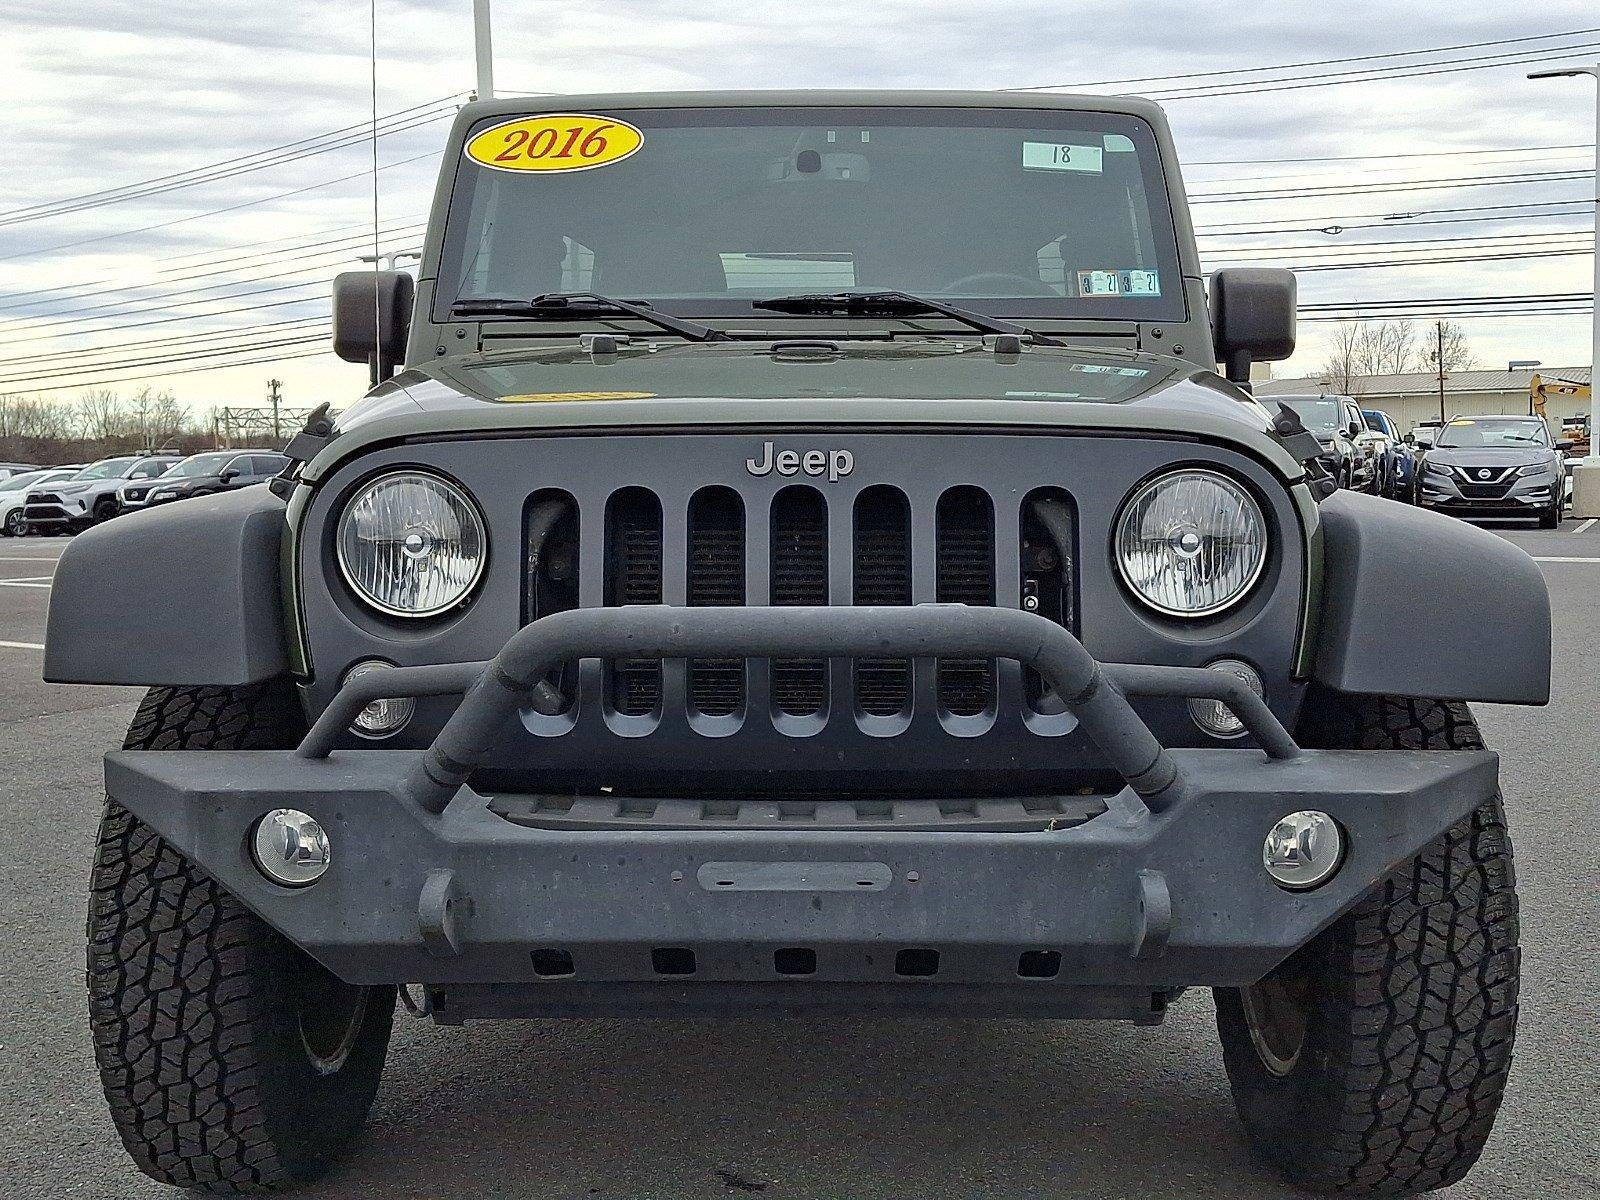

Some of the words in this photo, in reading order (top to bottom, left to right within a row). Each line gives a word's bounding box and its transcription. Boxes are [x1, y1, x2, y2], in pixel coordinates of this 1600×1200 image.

[494, 125, 615, 162] 2016
[1053, 146, 1071, 163] 18
[1083, 277, 1091, 293] 3
[1106, 274, 1116, 292] 27
[1123, 276, 1131, 292] 3
[1146, 273, 1156, 292] 27
[746, 441, 855, 483] Jeep
